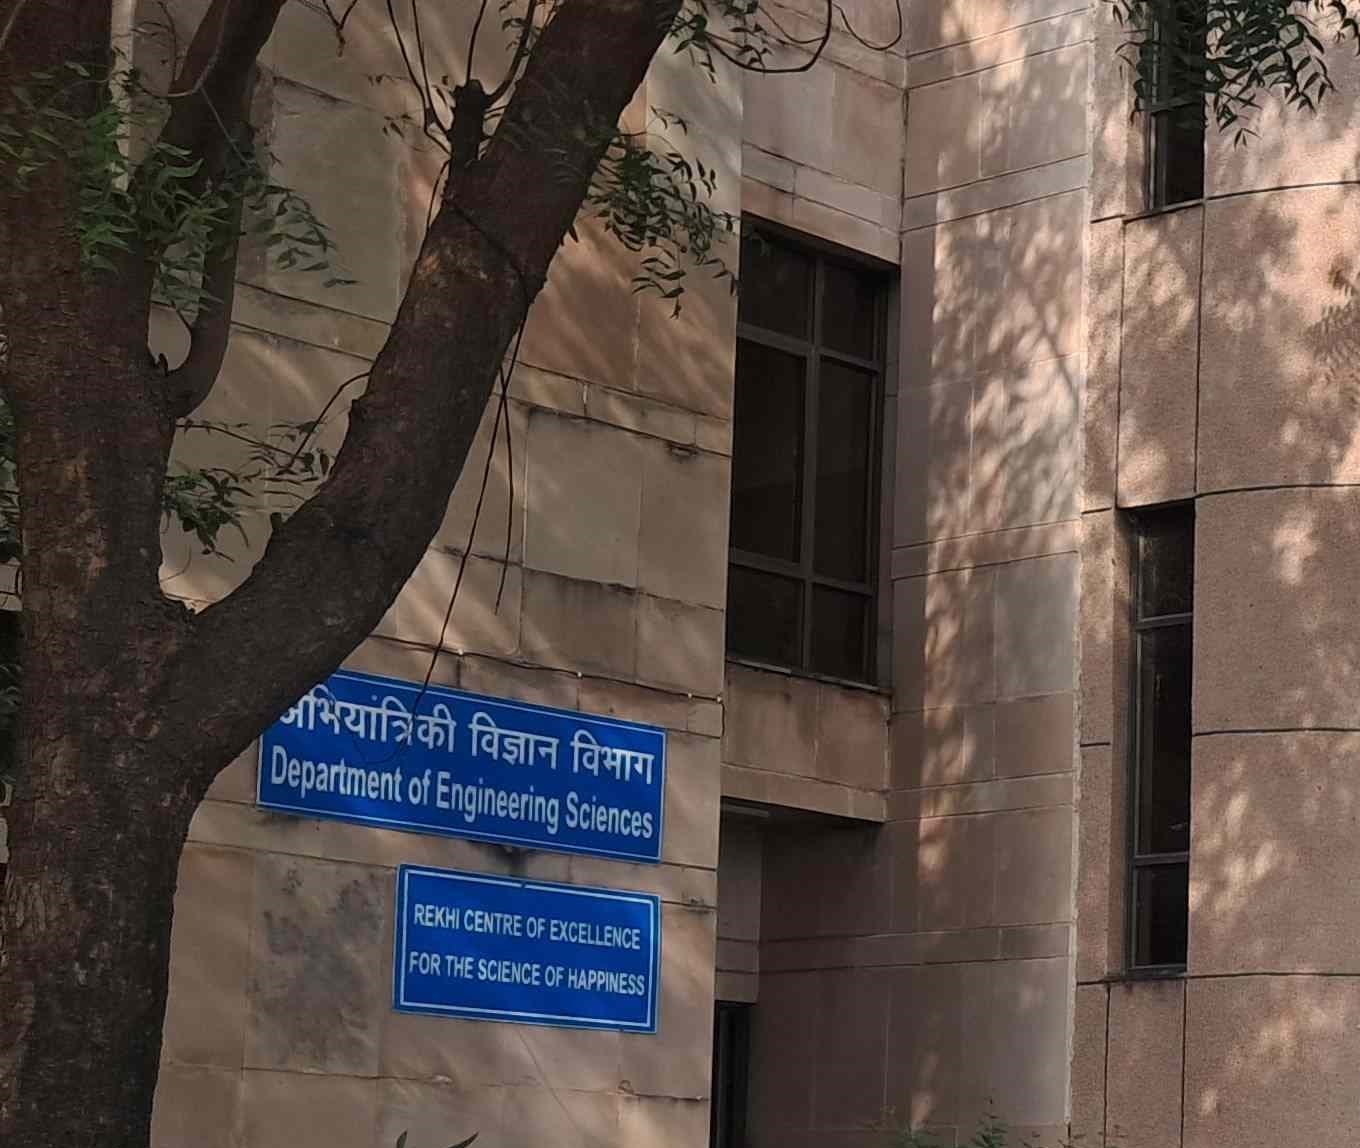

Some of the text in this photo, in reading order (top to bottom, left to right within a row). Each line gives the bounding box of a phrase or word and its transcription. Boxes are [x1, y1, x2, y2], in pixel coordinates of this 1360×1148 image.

[468, 711, 560, 770] विज्ञान
[570, 729, 655, 785] विभाग
[271, 745, 653, 838] Department of Engineering Sciences
[414, 903, 641, 950] REKHI CENTRE OF EXCELLENCE
[409, 951, 645, 996] FOR THE SCIENCE OF HAPPINESS
